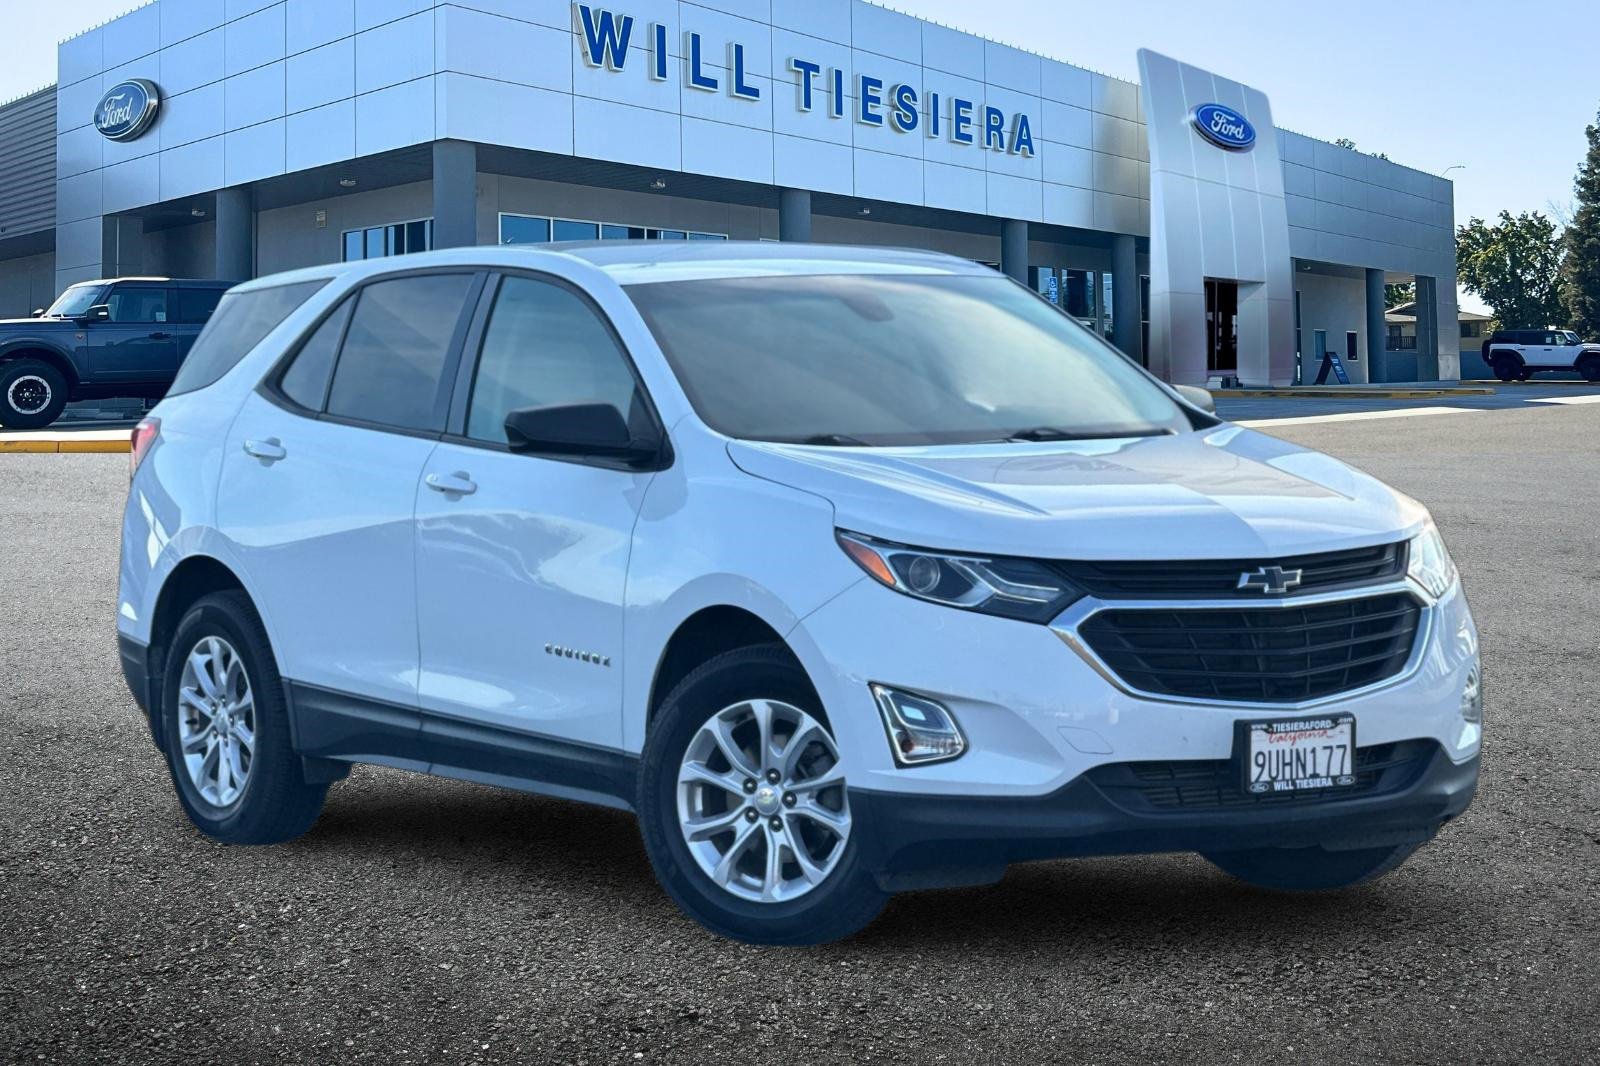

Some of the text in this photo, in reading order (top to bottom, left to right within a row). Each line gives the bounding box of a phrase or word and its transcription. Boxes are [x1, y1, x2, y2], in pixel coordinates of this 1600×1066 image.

[575, 3, 1035, 158] WILL TIESIERA
[102, 93, 133, 128] Ford
[1211, 111, 1245, 139] Ford
[1254, 744, 1347, 782] 9UHN177
[1273, 777, 1333, 791] WILL TIESIERA
